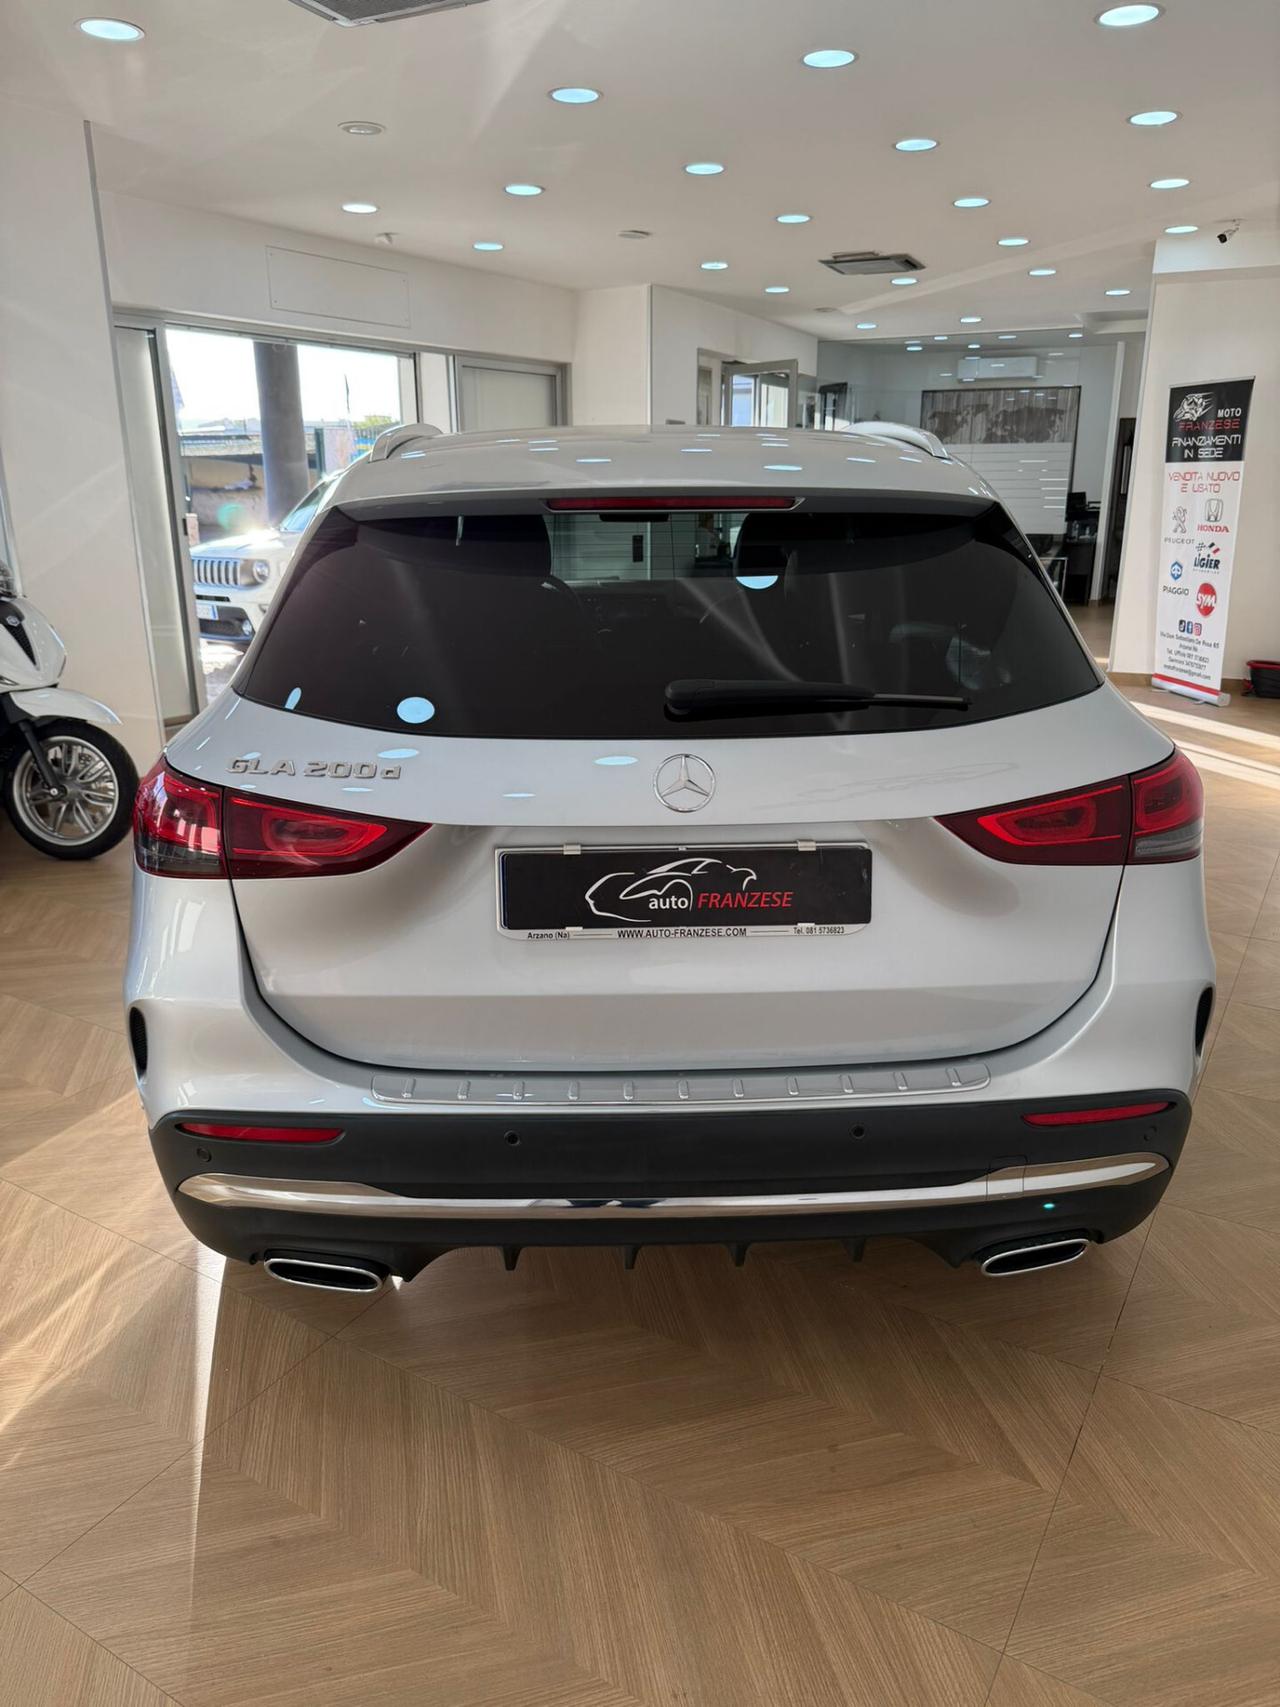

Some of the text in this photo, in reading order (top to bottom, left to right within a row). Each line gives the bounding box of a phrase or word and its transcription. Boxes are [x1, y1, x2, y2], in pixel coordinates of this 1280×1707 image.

[1218, 408, 1242, 418] MOTO
[1179, 419, 1240, 432] FRANZESE
[1172, 434, 1241, 447] FINANZIAMENTI
[1184, 447, 1224, 459] IN SEDE
[1169, 471, 1241, 482] VENDITA NUOVO
[1181, 483, 1221, 493] E USATO
[1197, 523, 1230, 533] HONDA
[1164, 537, 1195, 545] PEUGEOT
[1163, 585, 1190, 596] PIAGGIO
[1197, 593, 1217, 609] SYM
[226, 758, 296, 777] GLA
[648, 891, 794, 910] auto FRANZESE
[526, 930, 571, 941] Arzano (Na)
[617, 927, 747, 939] WWW.AUTO-FRANZESE.COM
[793, 926, 845, 935] Tel. 081 5736823
